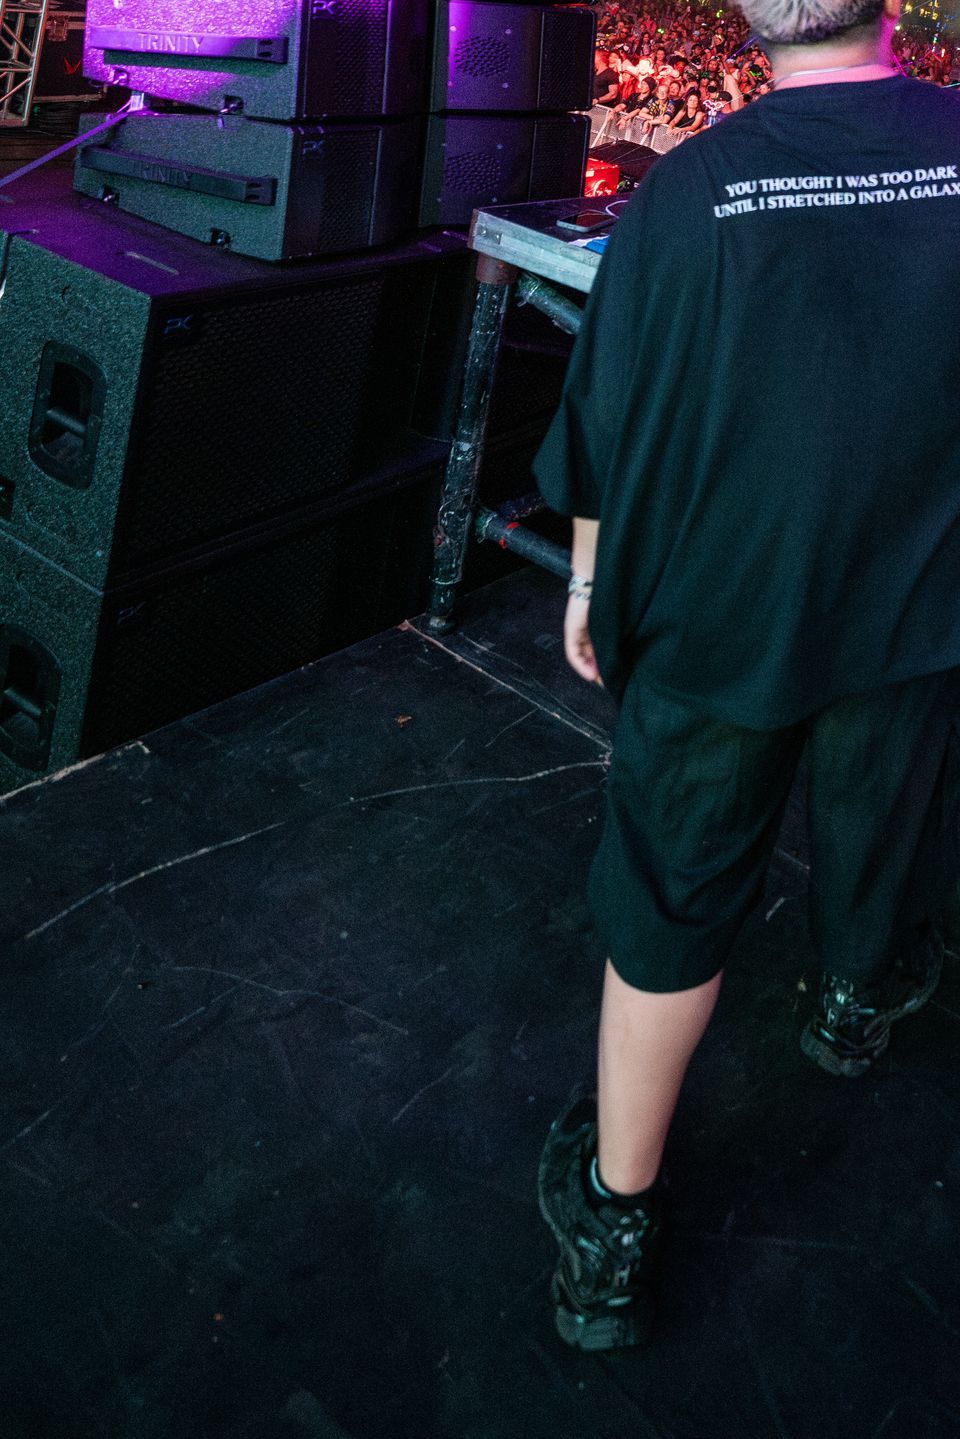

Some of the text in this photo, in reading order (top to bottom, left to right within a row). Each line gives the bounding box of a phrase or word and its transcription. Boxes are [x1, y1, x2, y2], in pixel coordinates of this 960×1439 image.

[138, 33, 203, 53] TRINITY
[725, 165, 958, 198] YOU THOUGHT I WAS TOO DARK
[713, 196, 757, 218] UNTIL
[758, 196, 766, 210] I
[767, 191, 855, 210] STRETCHED
[858, 189, 895, 205] INTO
[896, 187, 910, 201] A
